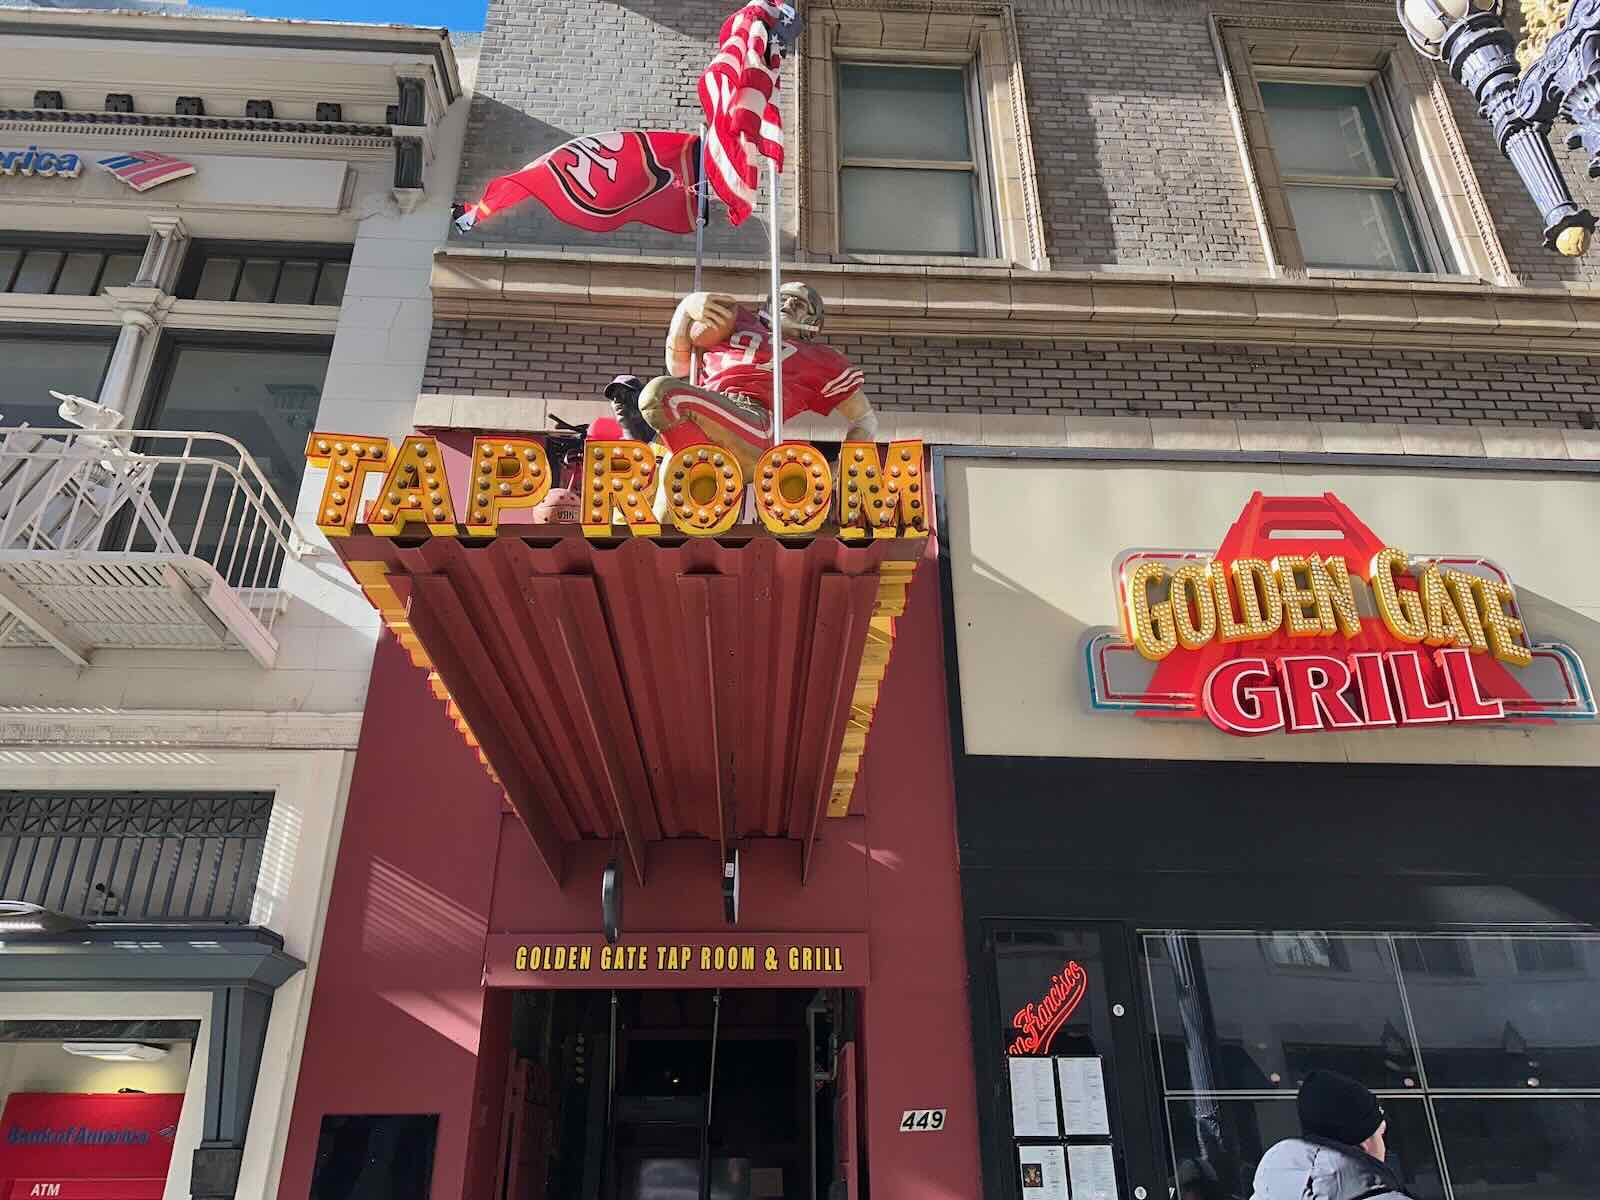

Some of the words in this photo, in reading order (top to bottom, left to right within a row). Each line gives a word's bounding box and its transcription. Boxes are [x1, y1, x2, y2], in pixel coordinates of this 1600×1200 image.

[0, 145, 80, 176] rica
[305, 431, 552, 538] TAP
[582, 439, 931, 540] ROOM
[1131, 552, 1361, 661] GOLDEN
[1369, 547, 1533, 667] GATE
[1203, 648, 1505, 737] GRILL
[515, 945, 592, 971] GOLDEN
[600, 945, 648, 971] GATE
[657, 945, 692, 971] TAP
[699, 945, 756, 971] ROOM
[765, 946, 779, 971] &
[788, 946, 844, 972] GRILL
[1013, 960, 1082, 1050] Francisco
[902, 1111, 943, 1130] 449
[30, 1183, 61, 1197] ATM
